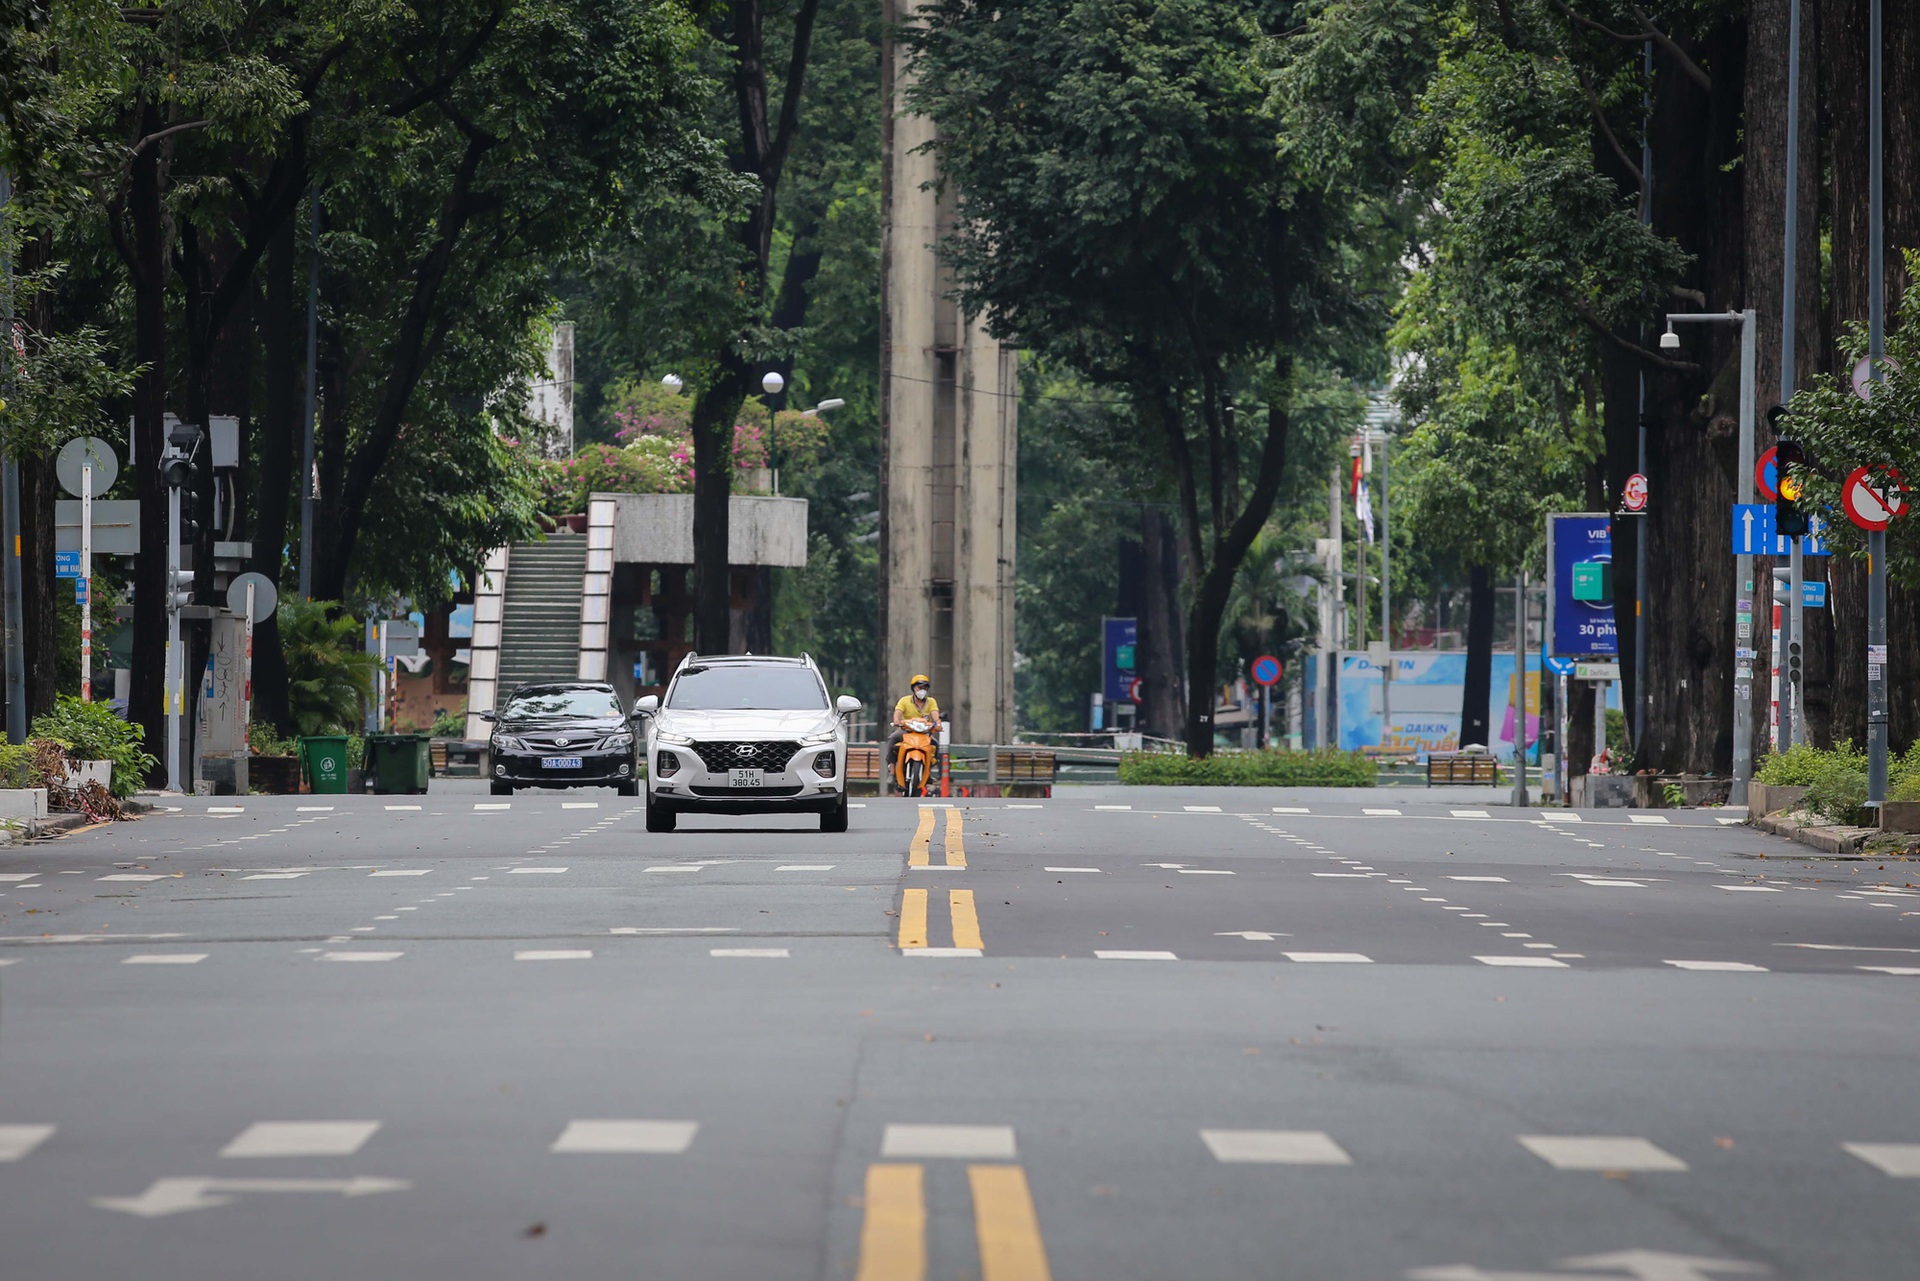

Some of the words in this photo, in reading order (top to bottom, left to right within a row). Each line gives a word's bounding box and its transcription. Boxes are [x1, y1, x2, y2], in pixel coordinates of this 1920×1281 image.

[1588, 530, 1607, 539] VIB
[1579, 625, 1595, 635] 30
[1358, 660, 1415, 670] DIN
[1405, 723, 1449, 734] DAIKIN
[739, 770, 755, 778] 51H
[732, 779, 761, 787] 380.45
